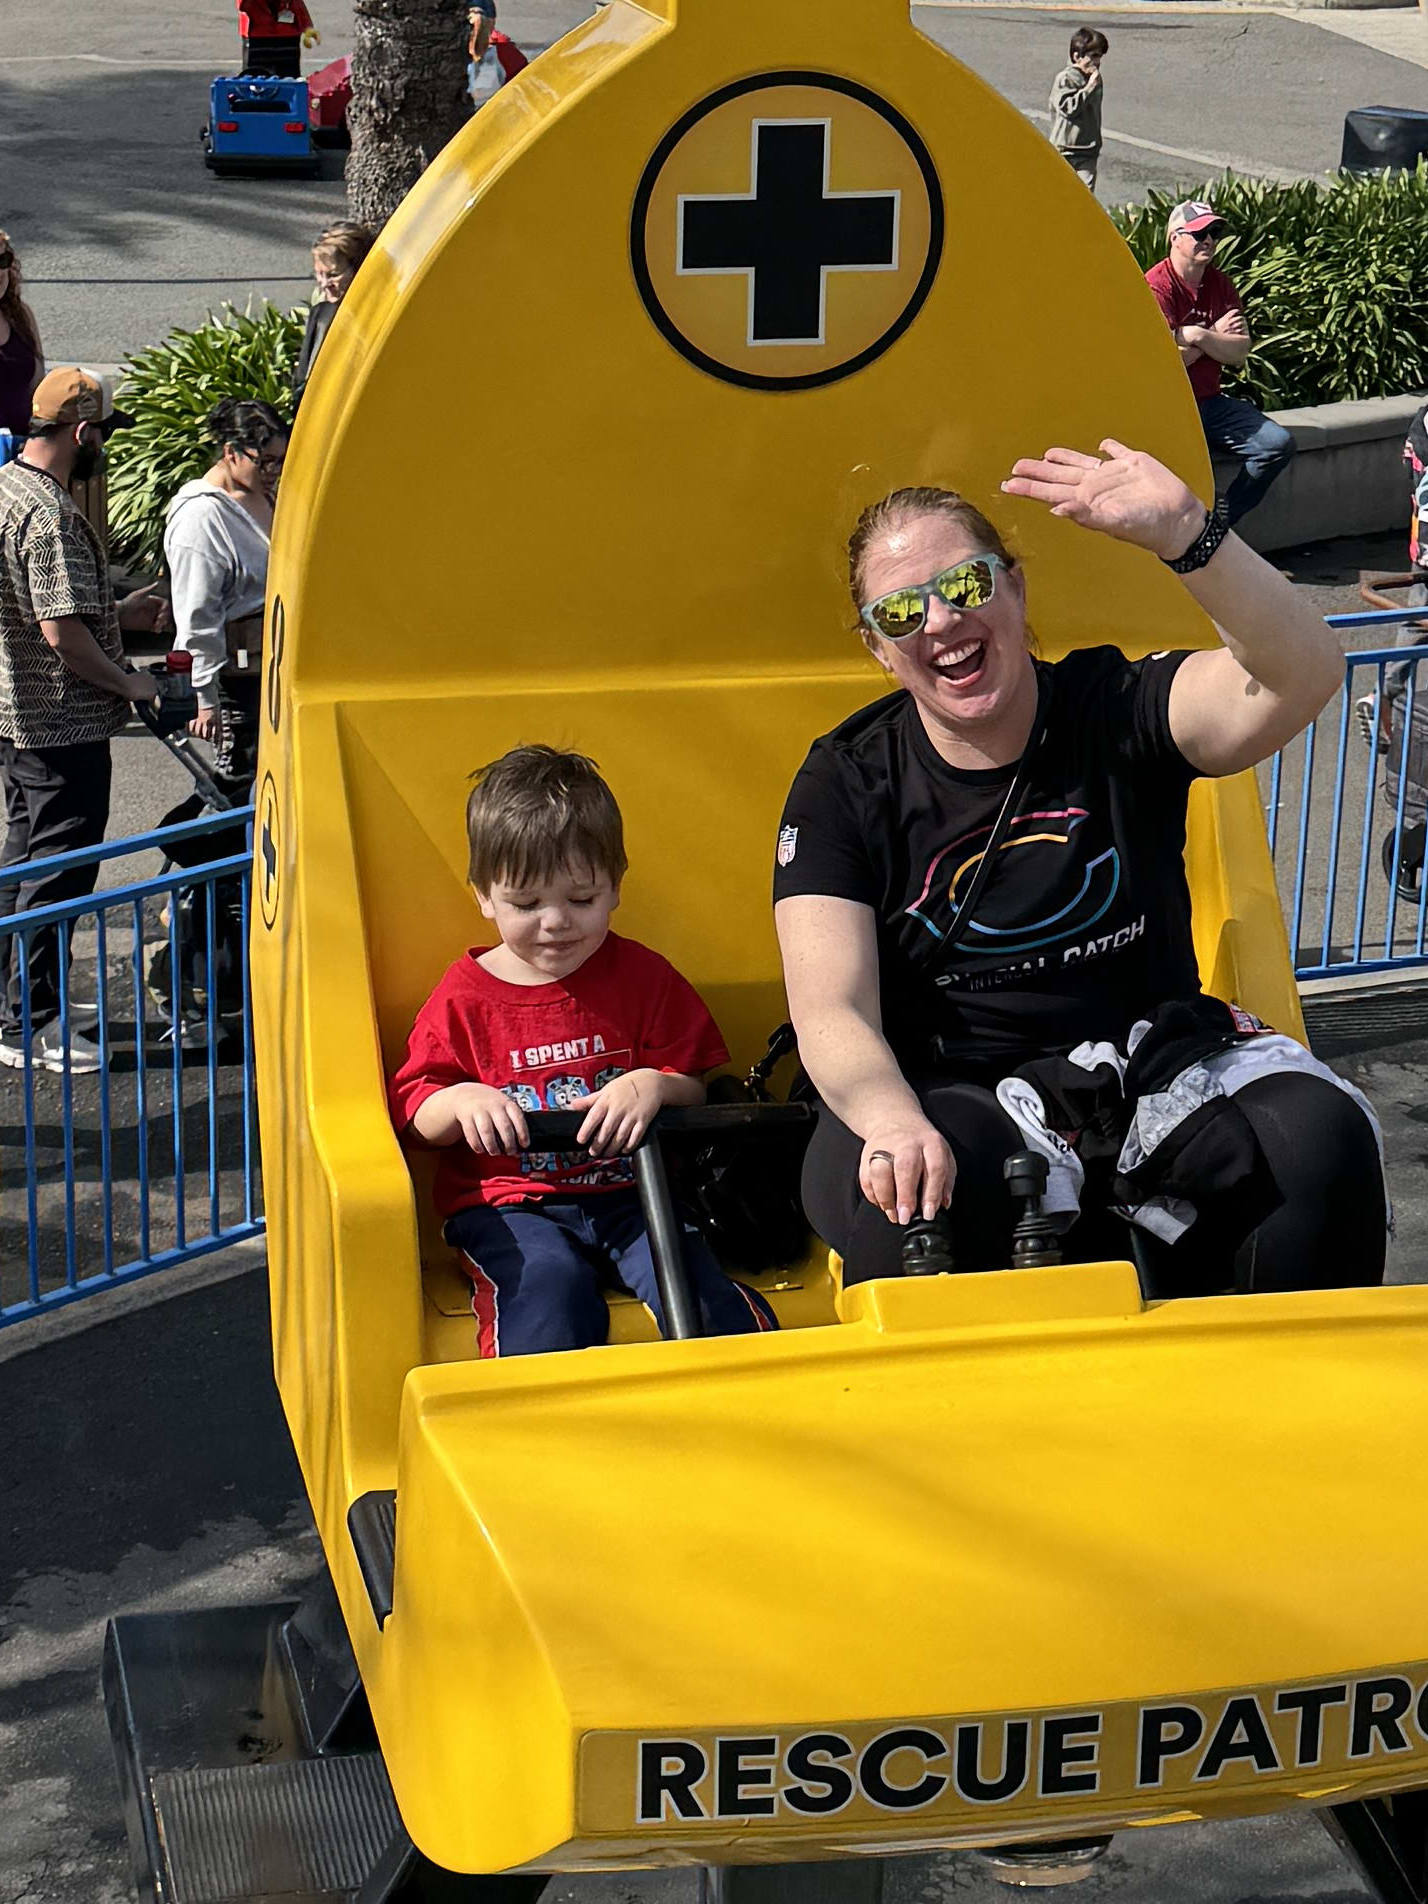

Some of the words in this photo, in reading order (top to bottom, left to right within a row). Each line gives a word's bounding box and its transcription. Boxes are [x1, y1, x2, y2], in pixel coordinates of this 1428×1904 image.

[268, 594, 285, 735] 8
[510, 1050, 523, 1069] I
[525, 1038, 589, 1066] SPENT
[593, 1034, 606, 1053] A
[636, 1712, 1102, 1824] RESCUE
